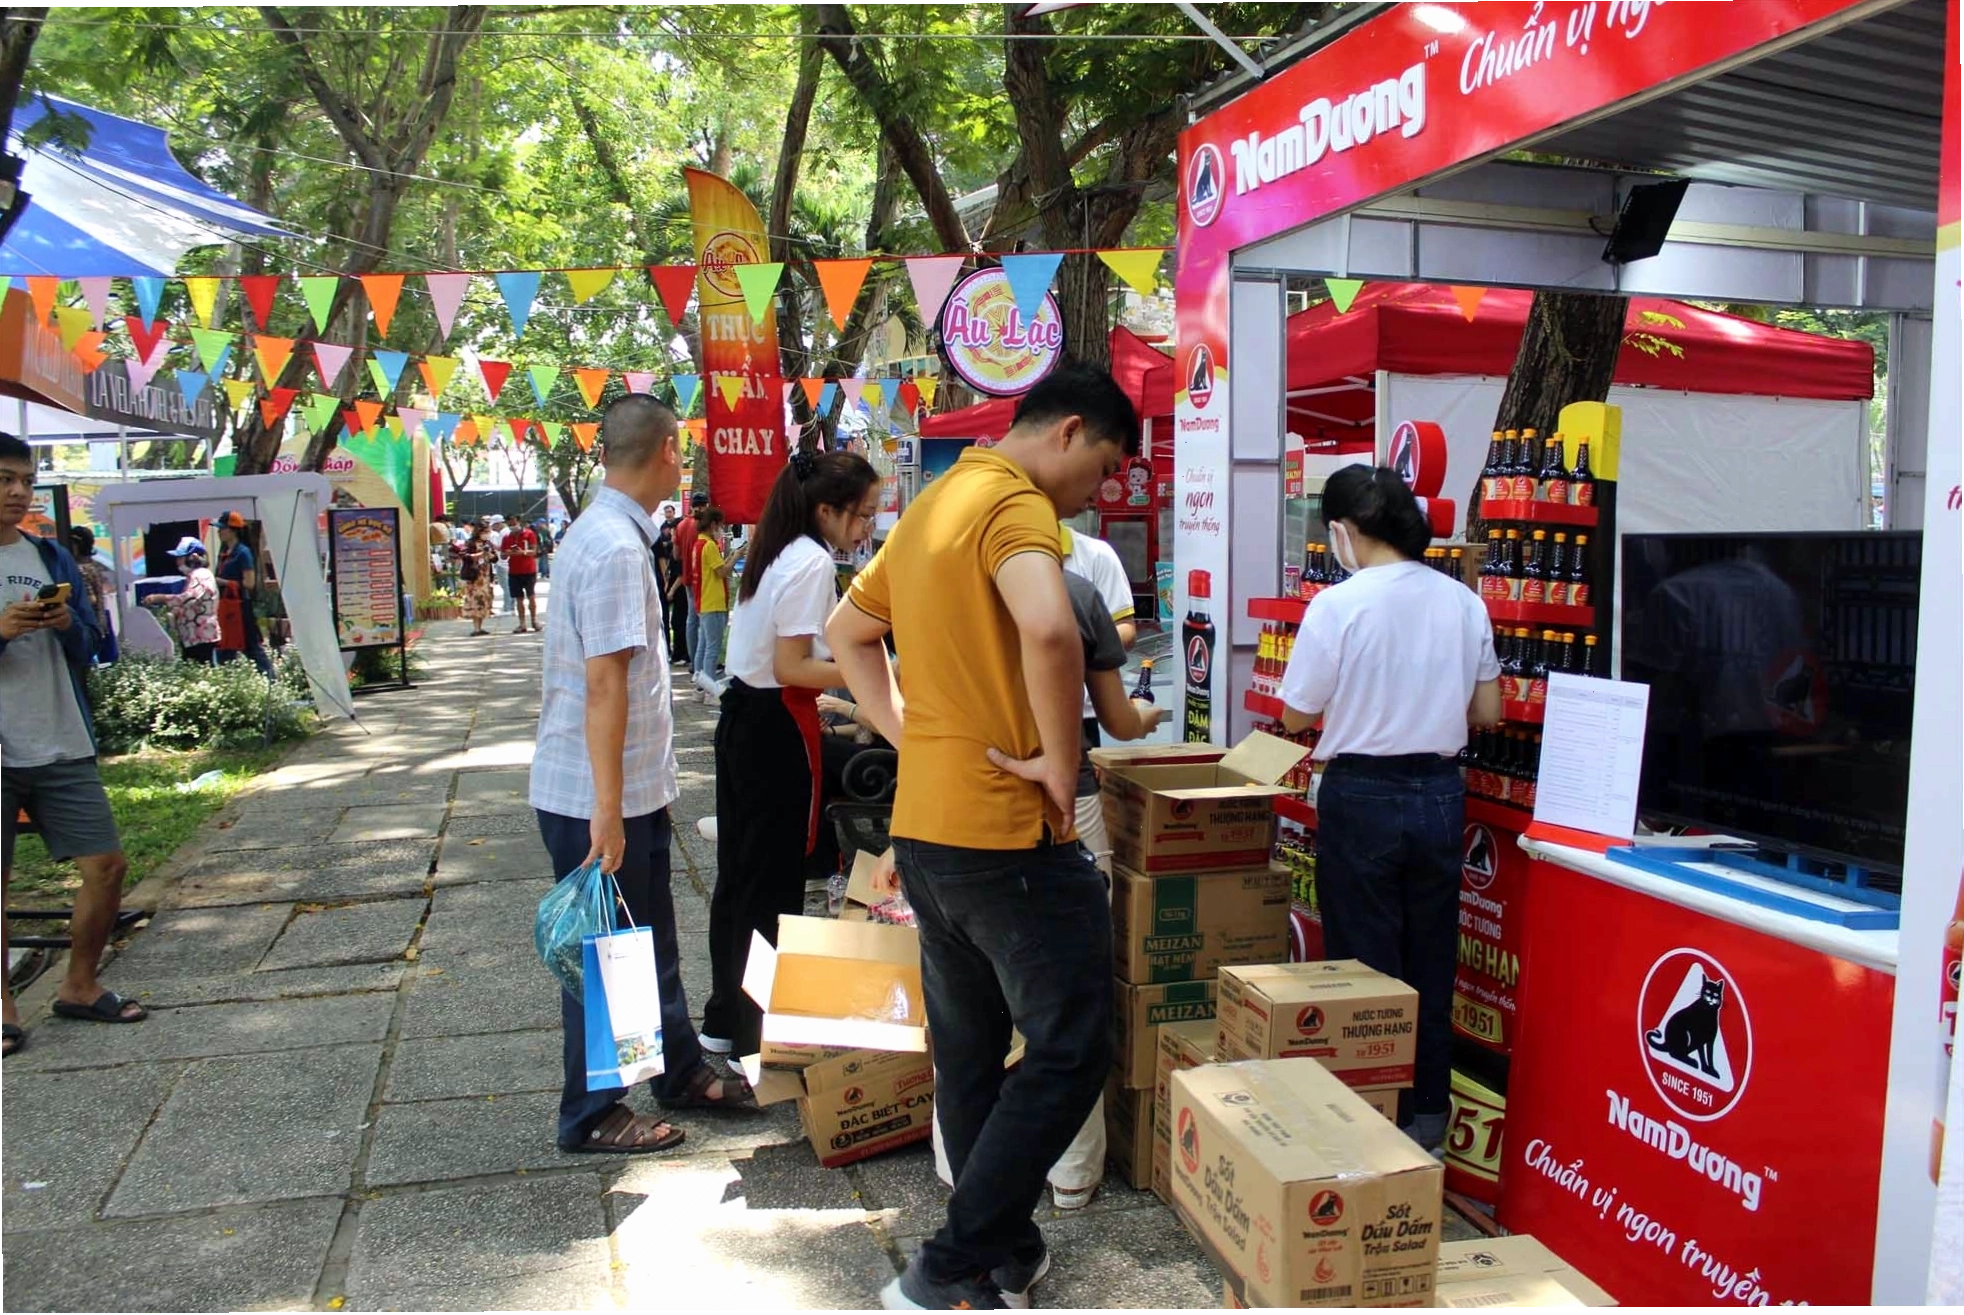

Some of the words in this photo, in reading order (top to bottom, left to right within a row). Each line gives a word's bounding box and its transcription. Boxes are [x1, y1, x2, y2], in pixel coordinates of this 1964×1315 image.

[1460, 1, 1556, 94] Chuẩn
[1566, 2, 1597, 55] vị
[1231, 62, 1427, 196] NamDương
[944, 296, 990, 345] Âu
[1002, 306, 1061, 354] Lạc
[92, 368, 109, 411] LA
[713, 427, 774, 456] CHAY
[1185, 488, 1214, 517] ngon
[7, 575, 42, 590] RIDE
[1459, 889, 1503, 918] amDương
[1146, 936, 1201, 951] MEIZAN
[1486, 943, 1519, 990] HẠN
[1151, 1001, 1217, 1022] MEIZAN
[1352, 1010, 1376, 1022] NƯỚC
[1377, 1008, 1404, 1020] TƯƠNG
[1461, 1003, 1494, 1036] 1951
[1342, 1023, 1383, 1040] THƯỢNG
[1384, 1021, 1413, 1037] HẠNG
[1367, 1043, 1396, 1056] 1951
[1662, 1072, 1690, 1097] SINCE
[1692, 1086, 1714, 1107] 1951
[872, 1101, 899, 1121] BIỆT
[906, 1091, 935, 1109] CAY
[1448, 1098, 1505, 1161] 51
[1606, 1088, 1762, 1212] NamDương
[1219, 1155, 1235, 1188] Sốt
[1386, 1201, 1412, 1220] Sốt
[1524, 1138, 1590, 1200] Chuẩn
[1592, 1187, 1618, 1220] vị
[1616, 1202, 1676, 1254] ngon
[1680, 1238, 1770, 1307] truyền
[1396, 1215, 1434, 1237] Dấm
[1392, 1238, 1428, 1252] Salad
